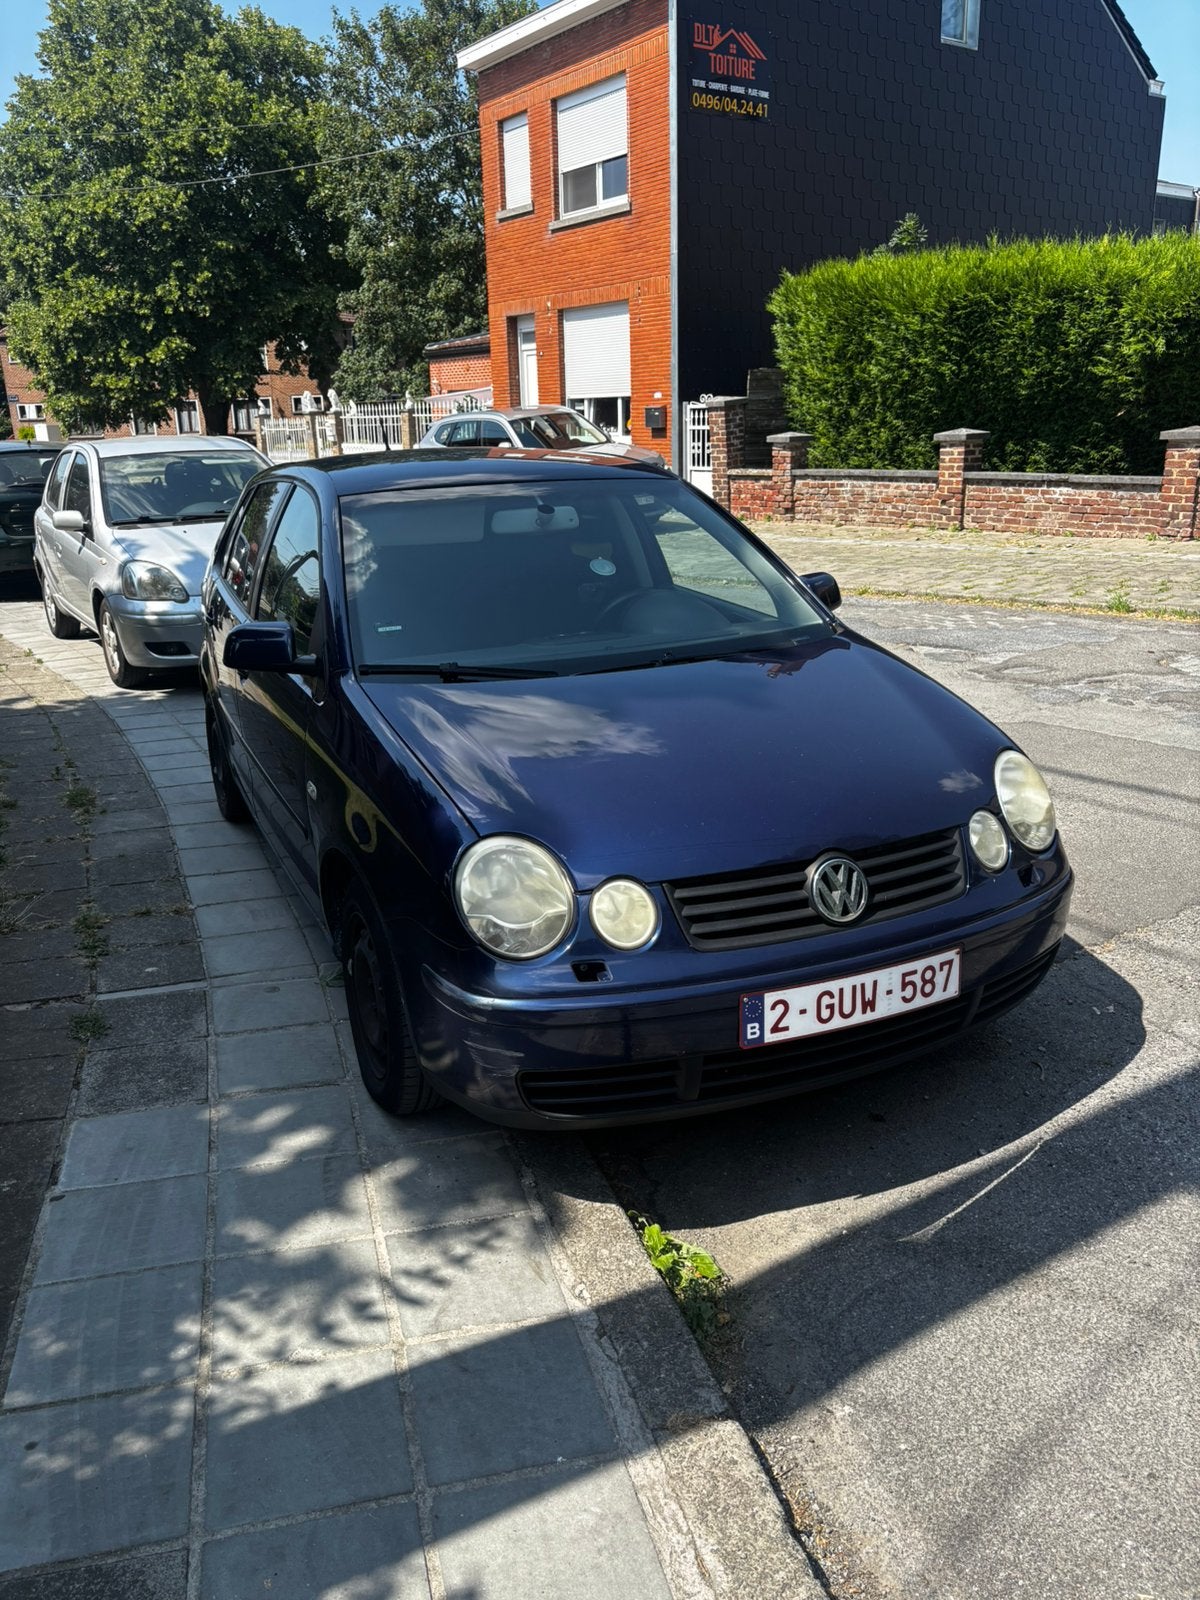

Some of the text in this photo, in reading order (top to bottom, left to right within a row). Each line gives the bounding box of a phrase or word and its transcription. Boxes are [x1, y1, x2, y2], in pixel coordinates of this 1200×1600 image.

[694, 22, 715, 45] DLT
[708, 52, 756, 80] TOITURE
[692, 92, 768, 118] 0496/04.24.41
[769, 958, 954, 1035] 2-GUW-587
[746, 1022, 761, 1040] B
